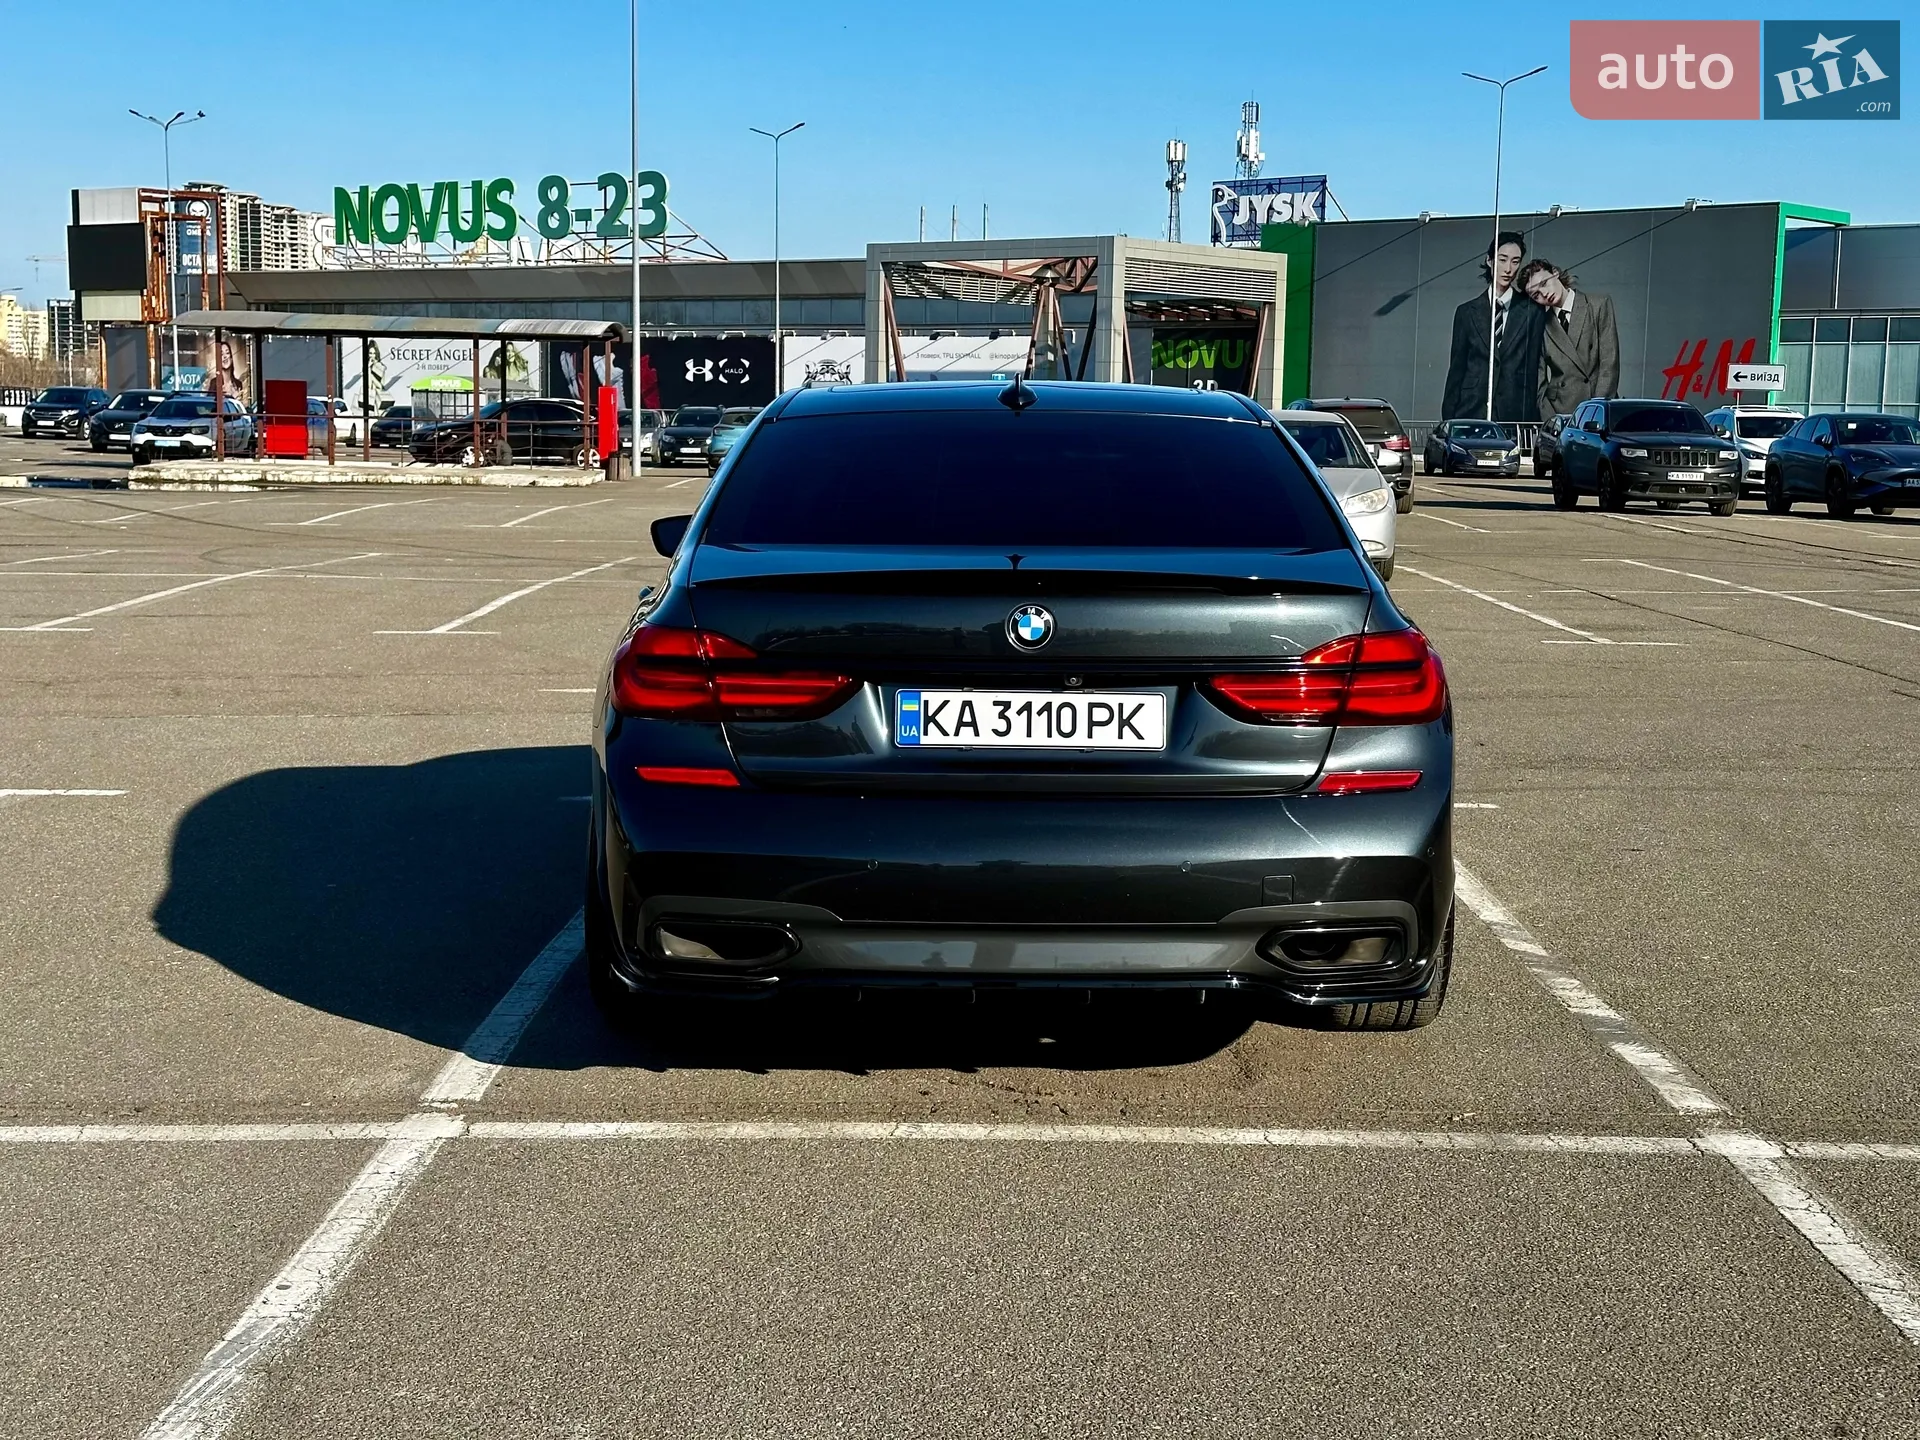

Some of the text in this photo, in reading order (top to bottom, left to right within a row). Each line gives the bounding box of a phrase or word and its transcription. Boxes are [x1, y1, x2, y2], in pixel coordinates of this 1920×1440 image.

[333, 170, 669, 245] NOVUS 8-23
[1232, 192, 1320, 225] JYSK
[1152, 339, 1253, 368] NOVU
[1661, 338, 1755, 401] H&M
[430, 379, 462, 387] NOVUS
[901, 727, 919, 736] UA
[923, 699, 1145, 740] KA 3110 PK
